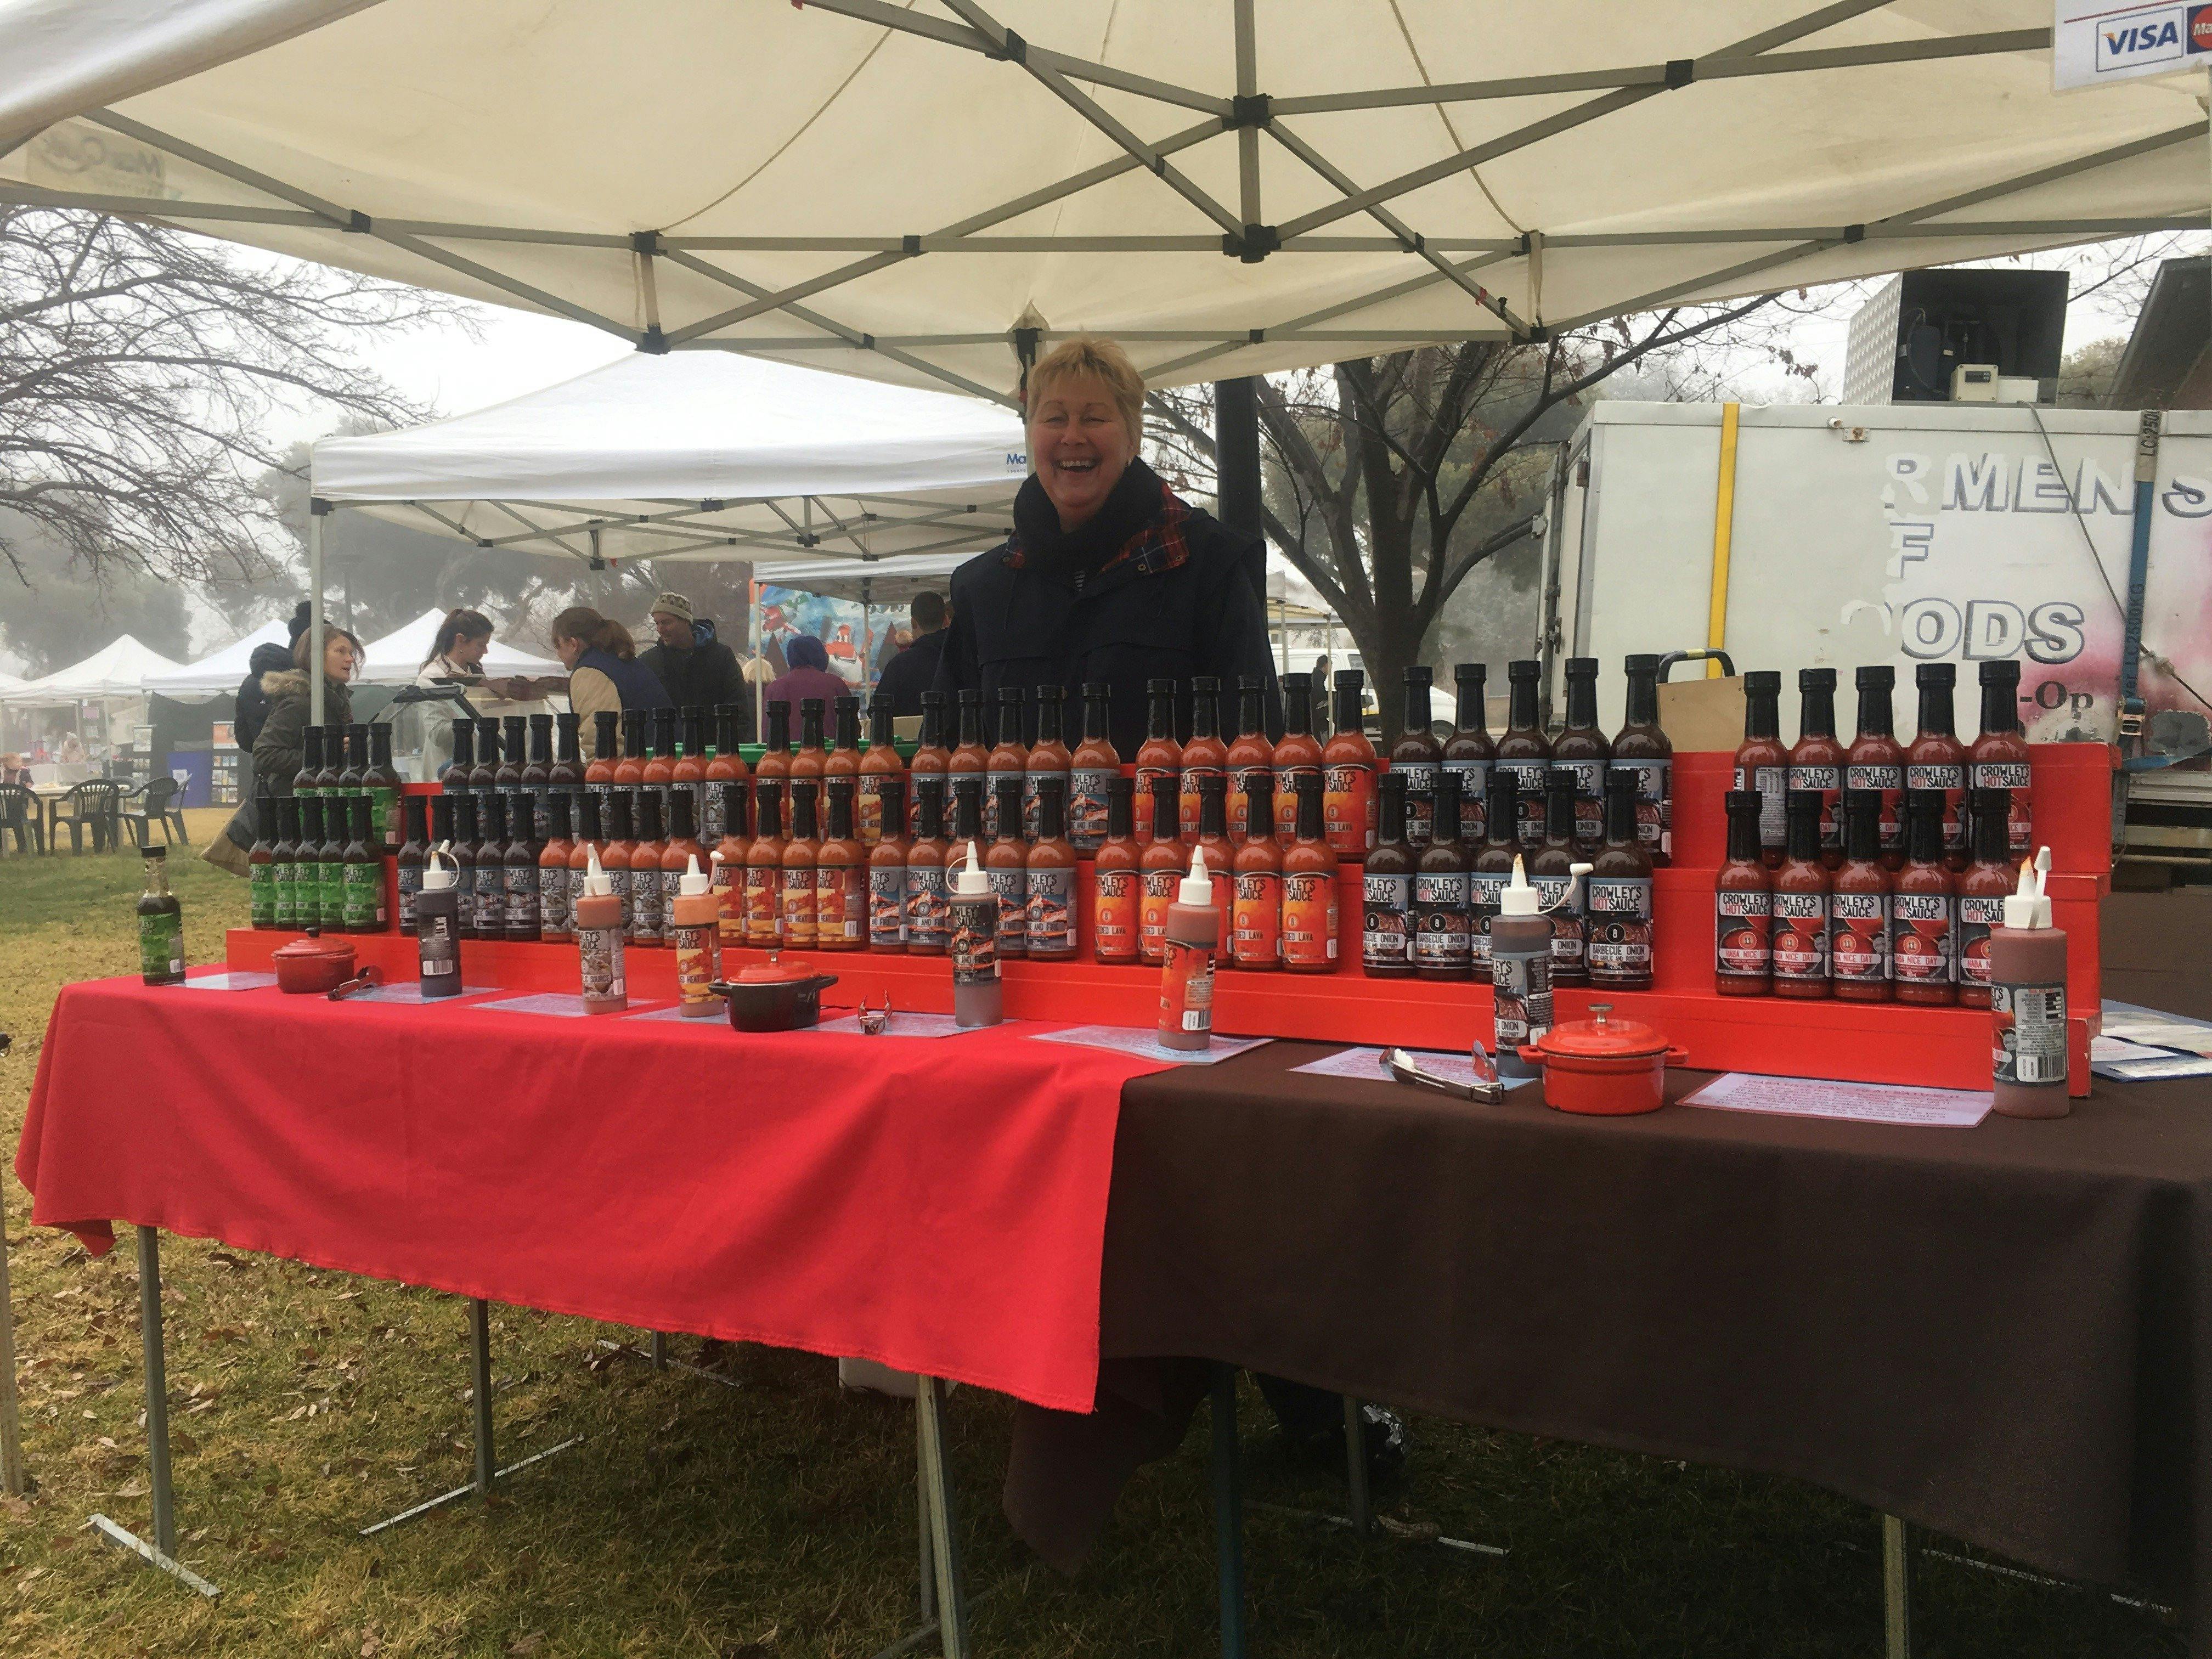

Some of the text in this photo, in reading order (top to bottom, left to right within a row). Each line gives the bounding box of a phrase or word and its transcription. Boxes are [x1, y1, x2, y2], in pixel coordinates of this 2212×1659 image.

[2102, 21, 2212, 55] VISA Ma
[1006, 453, 1027, 465] Ma
[2019, 679, 2094, 719] -Op
[1964, 899, 2005, 911] CROWLE
